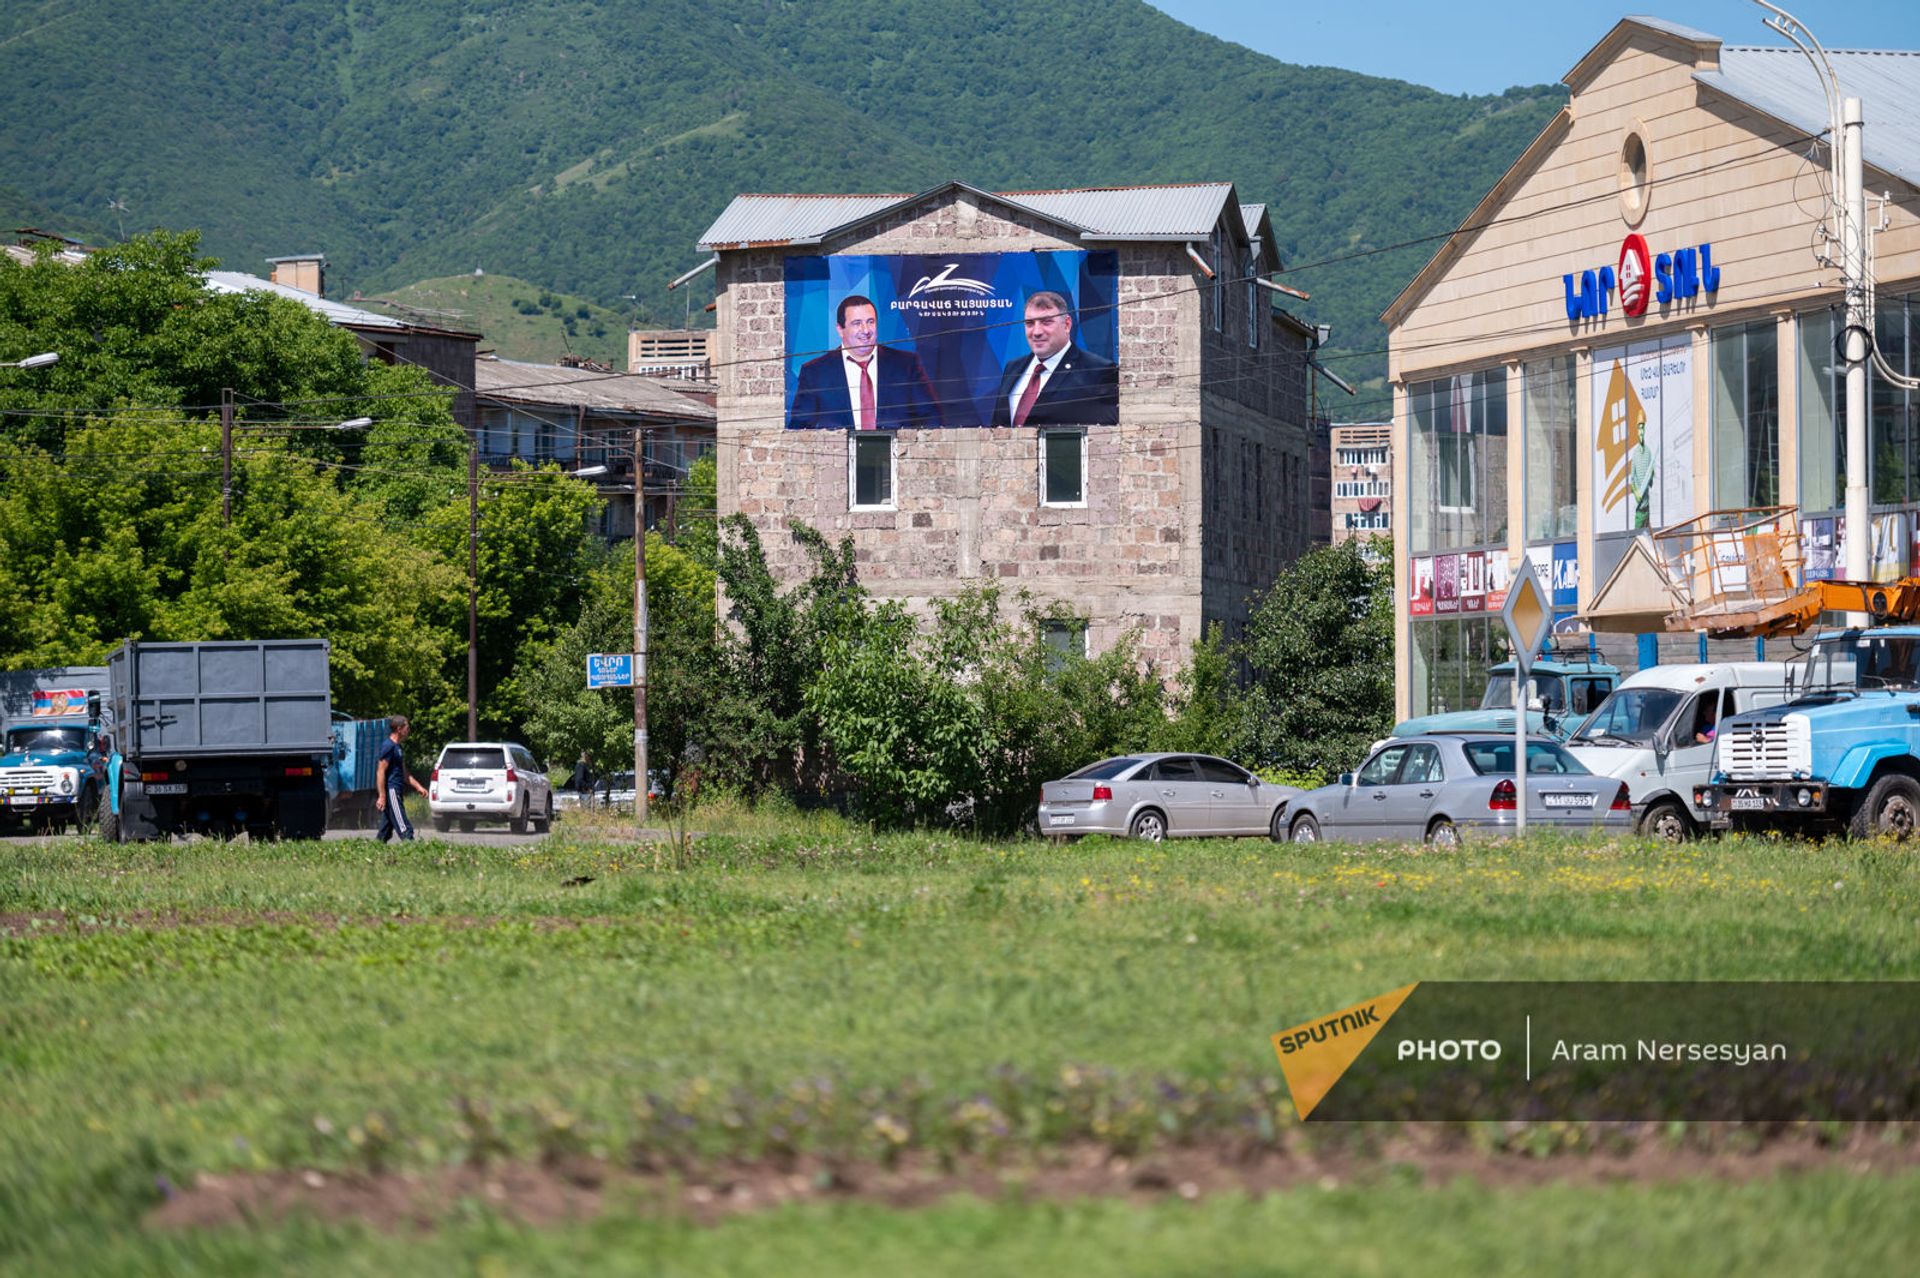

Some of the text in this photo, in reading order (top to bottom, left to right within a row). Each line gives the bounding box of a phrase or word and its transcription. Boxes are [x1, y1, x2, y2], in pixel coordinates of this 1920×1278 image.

[1563, 243, 1721, 320] ՆՈՐ ՏՈՒՆ
[890, 299, 1013, 310] ԲԱՐԳԱՎԱՃ ՀԱՅԱՍՏԱՆ
